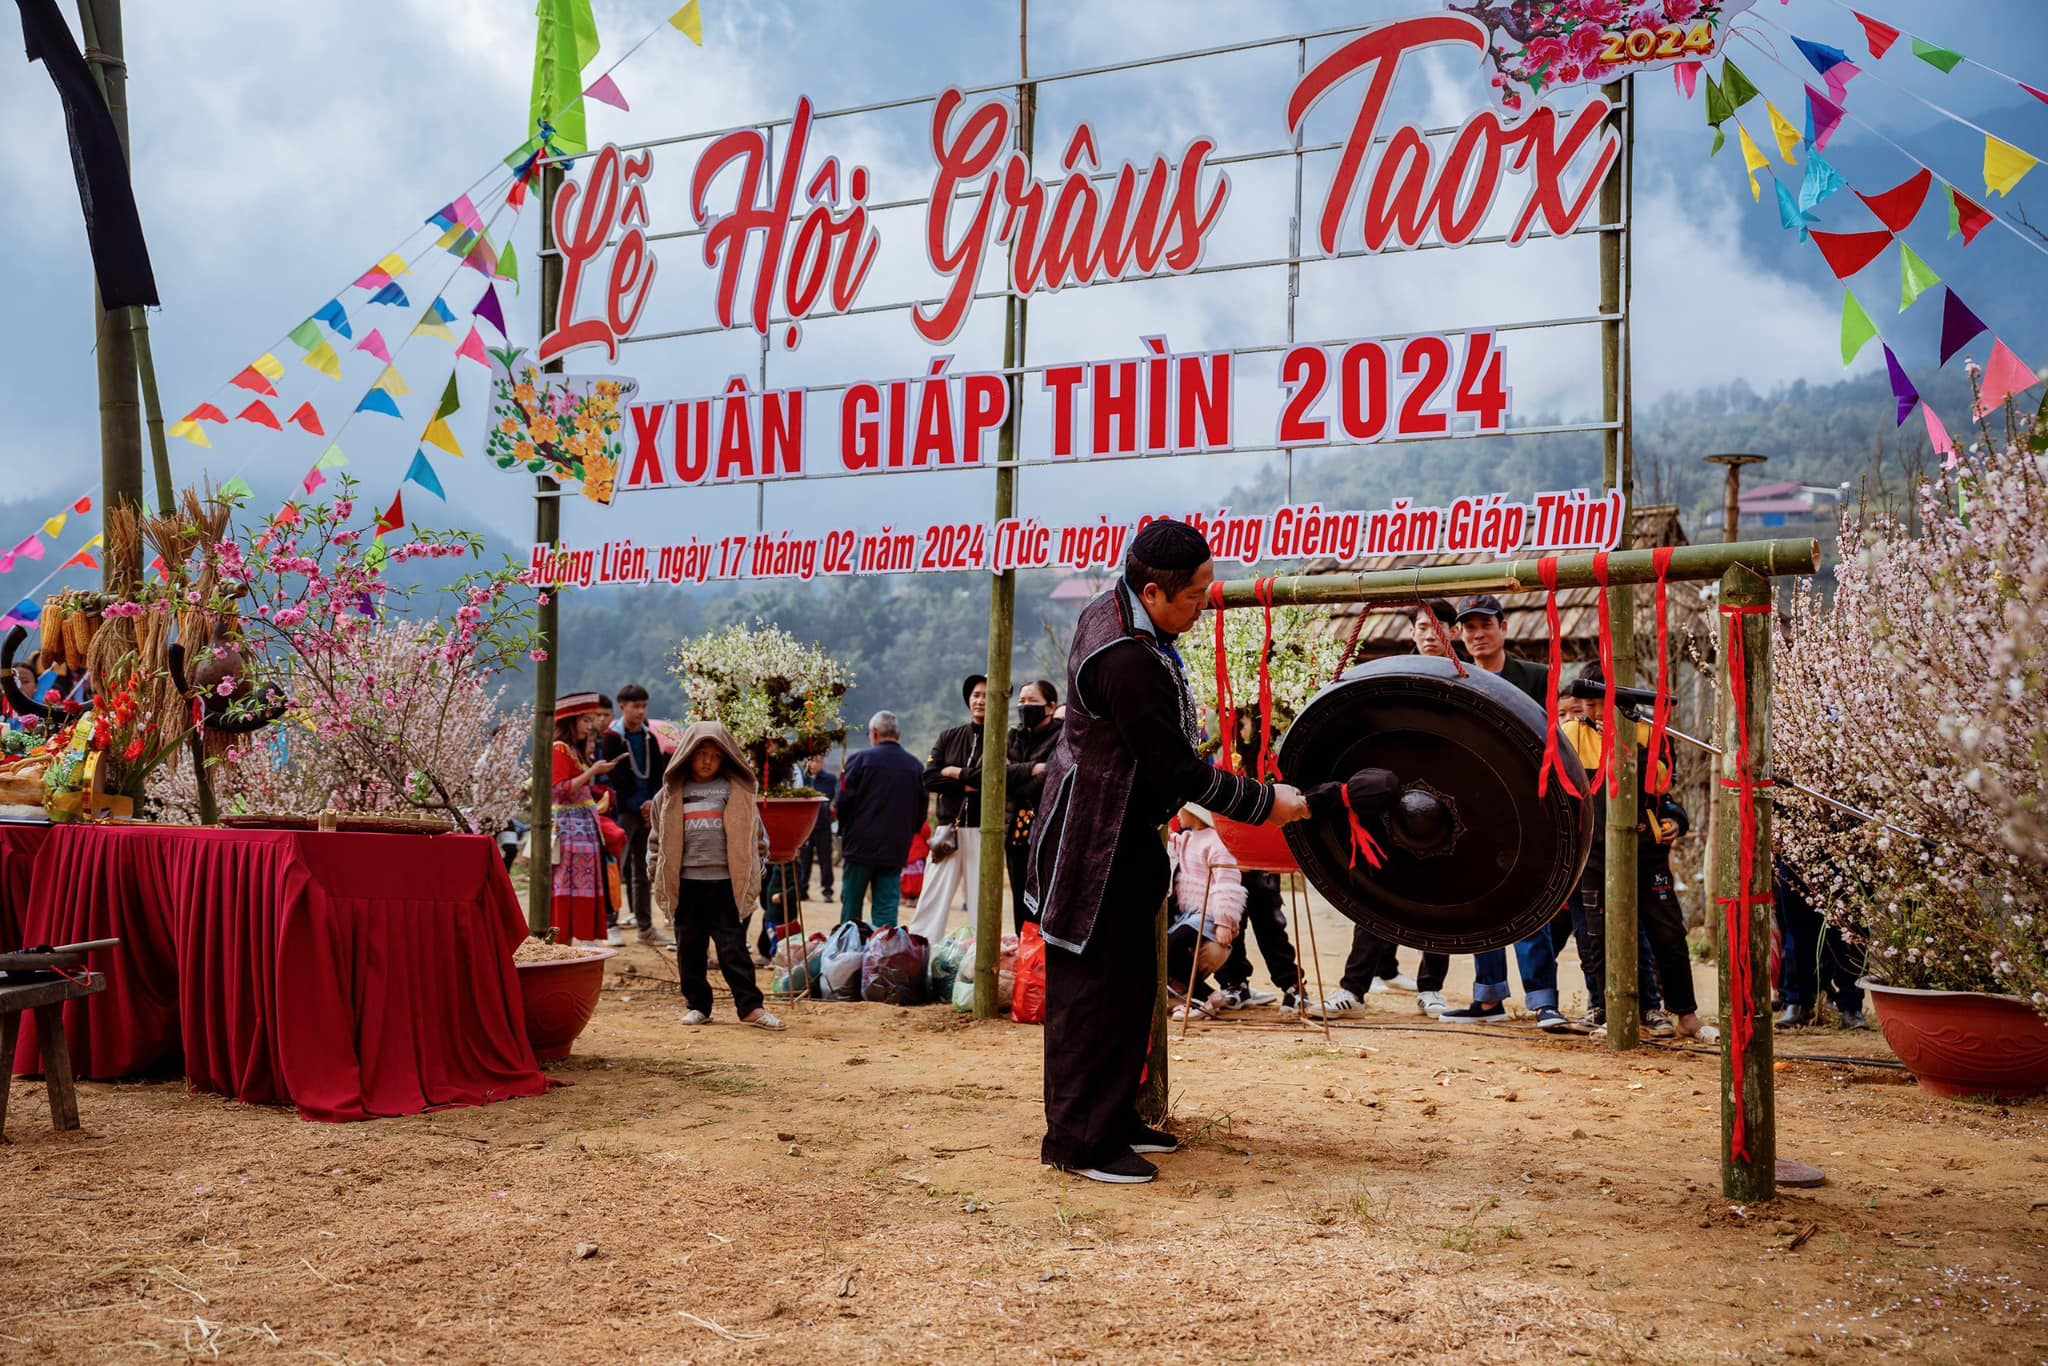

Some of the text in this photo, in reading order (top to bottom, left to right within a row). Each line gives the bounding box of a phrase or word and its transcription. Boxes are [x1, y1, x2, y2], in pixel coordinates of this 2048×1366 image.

[1599, 22, 1715, 64] 2024
[538, 18, 1618, 360] Lễ Hội Grâus Taox
[628, 333, 1508, 487] XUÂN GIÁP THÌN 2024
[600, 539, 649, 584] Liên,
[658, 535, 712, 585] ngày
[719, 536, 747, 577] 17
[751, 530, 817, 580] tháng
[822, 530, 856, 573] 02
[860, 526, 916, 572] năm
[921, 524, 984, 569] 2024
[994, 518, 1050, 570] (Tức
[1058, 516, 1127, 570] ngày
[1271, 505, 1360, 561] Giêng
[1366, 503, 1439, 554] năm
[1447, 497, 1524, 555] Giáp
[1535, 493, 1622, 549] Thìn)
